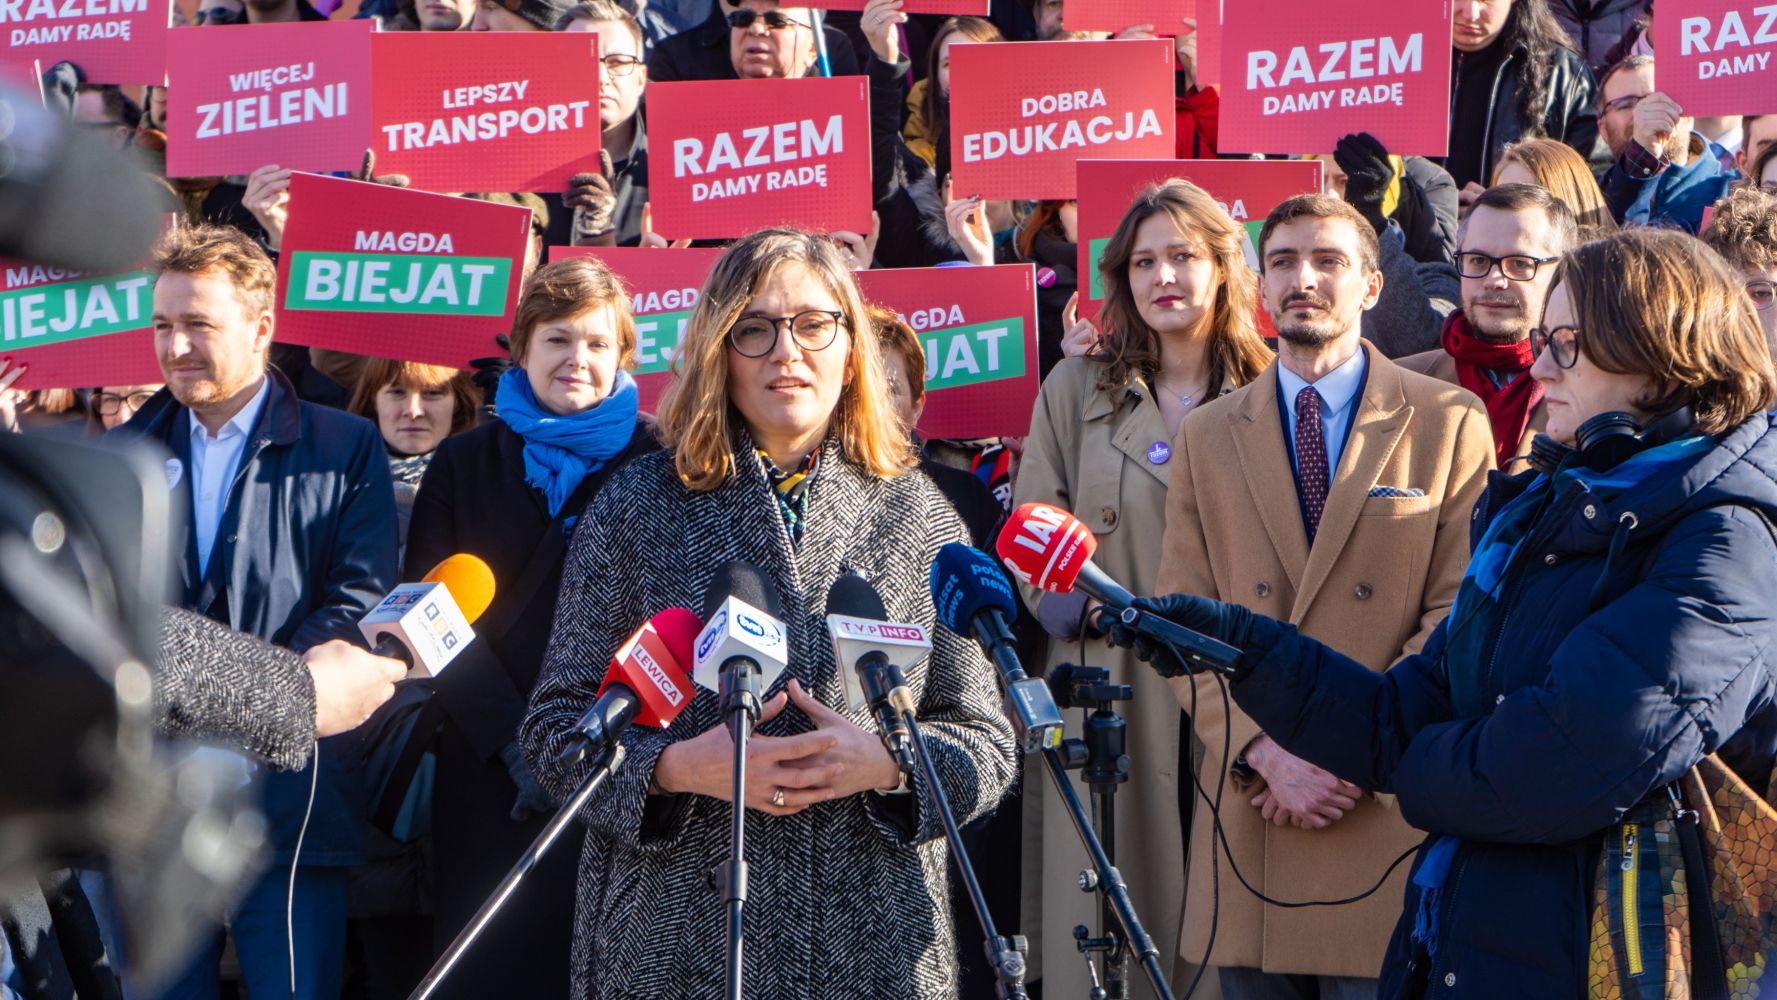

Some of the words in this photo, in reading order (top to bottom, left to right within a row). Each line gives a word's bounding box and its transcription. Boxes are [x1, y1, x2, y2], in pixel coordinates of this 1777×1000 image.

[0, 0, 148, 23] RAZEM
[1681, 4, 1777, 56] RAZ
[10, 24, 74, 47] DAMY
[76, 20, 132, 42] RADĘ
[229, 61, 314, 92] WIĘCEJ
[1246, 32, 1423, 90] RAZEM
[1698, 51, 1771, 80] DAMY
[195, 82, 348, 139] ZIELENI
[442, 79, 528, 109] LEPSZY
[1021, 88, 1107, 118] DOBRA
[1263, 89, 1335, 116] DAMY
[1340, 81, 1403, 107] RADĘ
[381, 100, 590, 152] TRANSPORT
[963, 108, 1163, 163] EDUKACJA
[673, 114, 844, 178] RAZEM
[692, 173, 762, 202] DAMY
[766, 163, 828, 191] RADĘ
[354, 230, 454, 254] MAGDA
[6, 265, 82, 288] MAG
[304, 258, 495, 306] BIEJAT
[0, 276, 148, 341] IEJAT
[632, 287, 699, 313] AGD
[926, 327, 1008, 381] JAT
[1014, 506, 1067, 554] IAR
[841, 621, 877, 634] TVP
[880, 626, 920, 639] INFO
[635, 649, 678, 703] LEWICA
